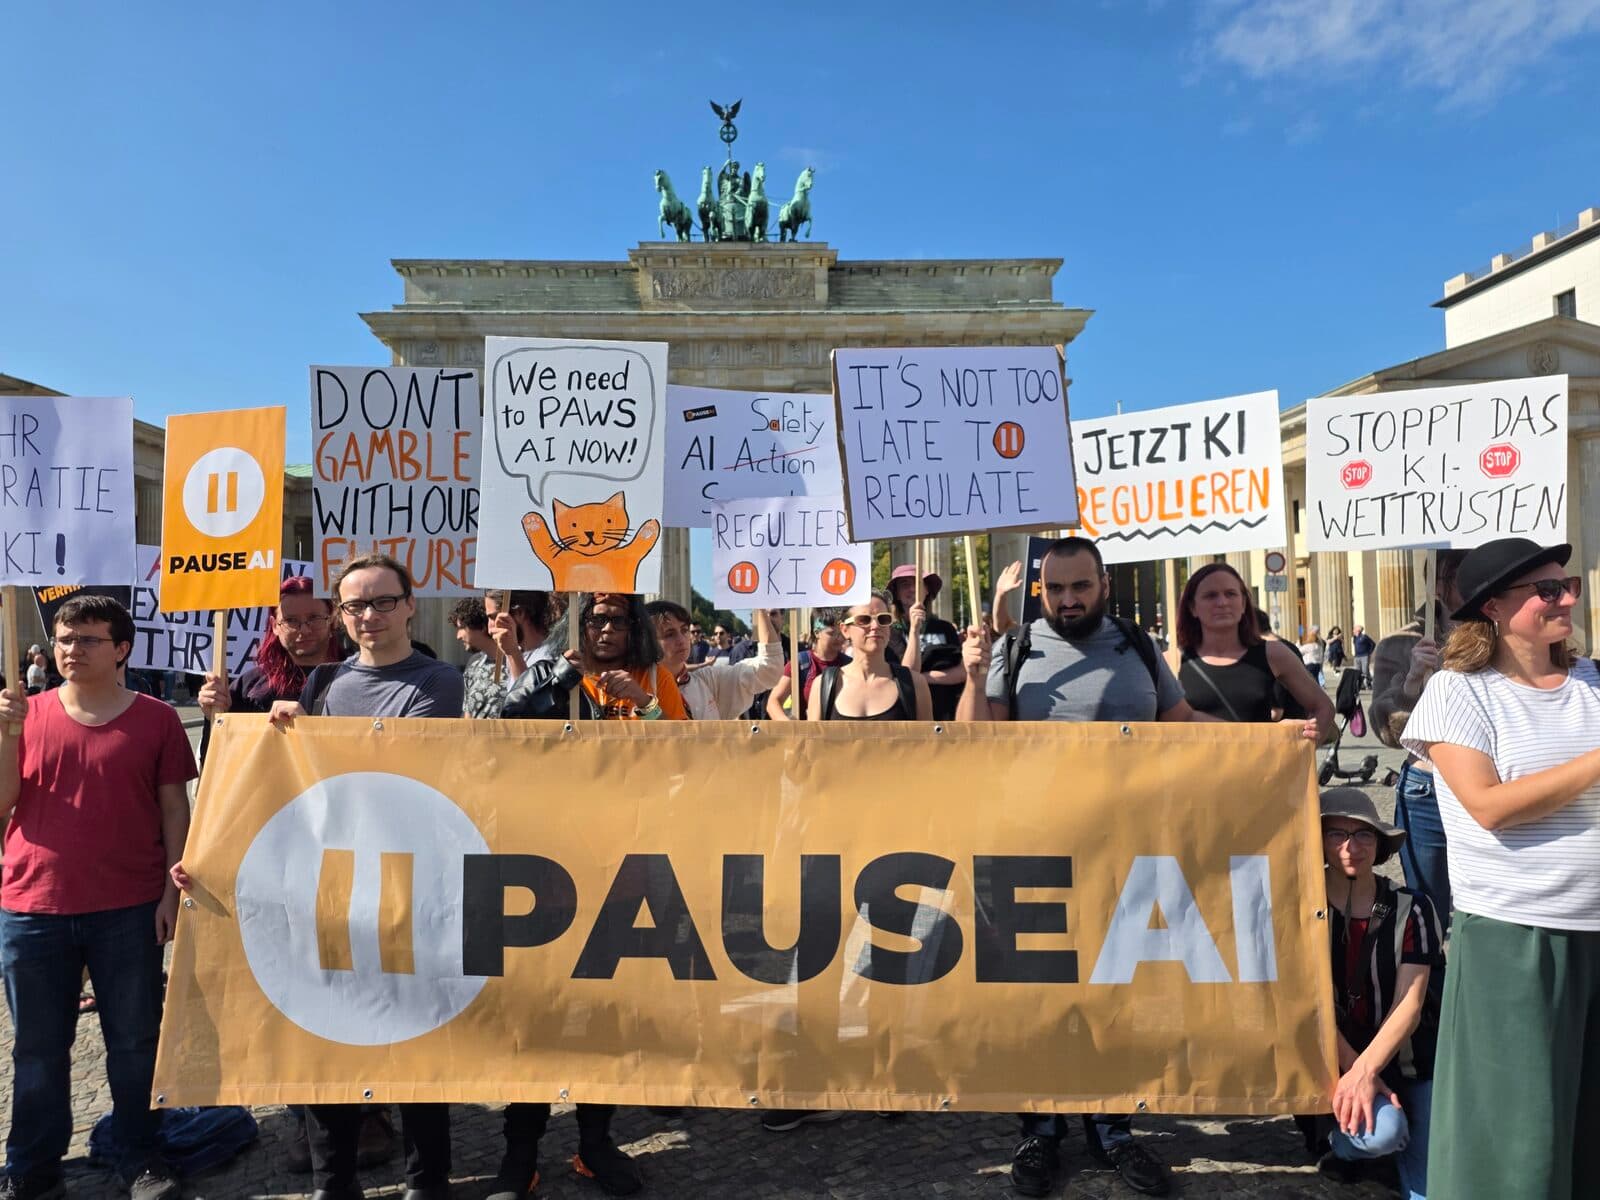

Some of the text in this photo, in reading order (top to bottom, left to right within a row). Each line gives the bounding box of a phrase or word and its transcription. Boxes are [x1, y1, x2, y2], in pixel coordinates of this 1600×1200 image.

[317, 368, 474, 430] DON'T
[508, 361, 630, 394] We need
[849, 356, 1059, 410] IT'S NOT TOO
[502, 397, 636, 428] to PAWS
[751, 398, 825, 444] Safety
[1326, 393, 1561, 456] STOPPT DAS
[315, 429, 473, 482] GAMBLE
[515, 437, 638, 464] AI NOW!
[681, 435, 816, 474] AI Action
[858, 420, 943, 463] LATE
[1082, 410, 1245, 475] JETZT KI
[1485, 450, 1513, 468] STOP
[865, 471, 1038, 519] REGULATE
[1344, 467, 1367, 482] STOP
[313, 483, 480, 535] WITH OUR
[1072, 467, 1271, 537] REGULIEREN
[1318, 482, 1565, 539] WETTRÜSTEN
[716, 510, 858, 550] REGULIER
[767, 558, 807, 595] KI
